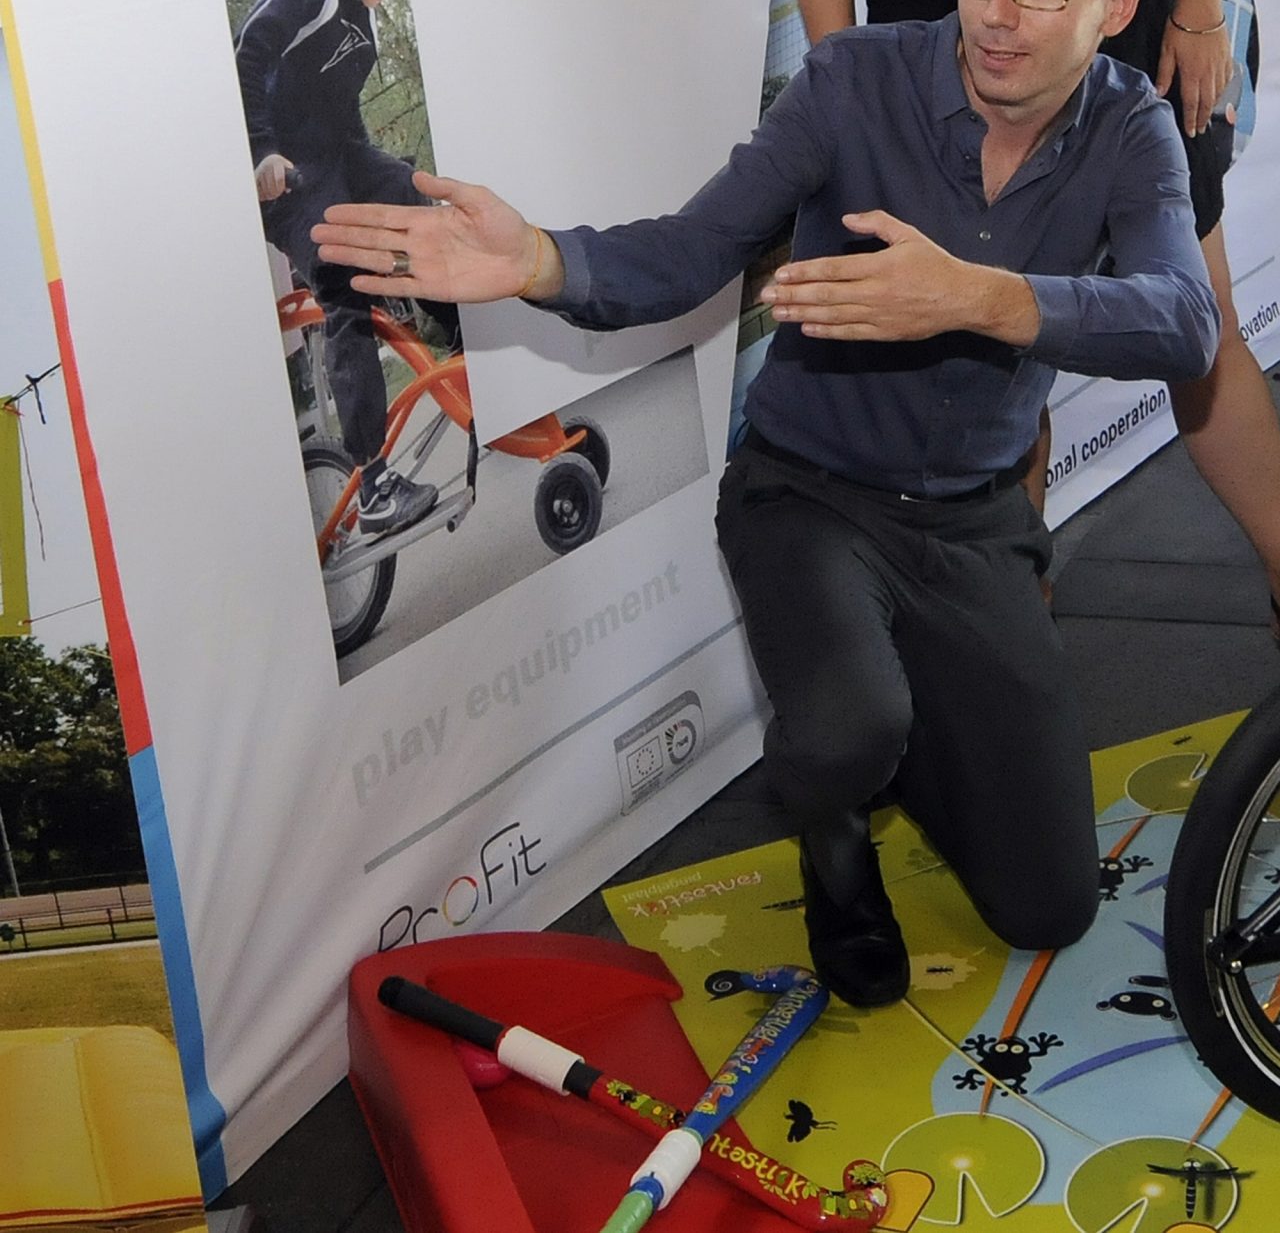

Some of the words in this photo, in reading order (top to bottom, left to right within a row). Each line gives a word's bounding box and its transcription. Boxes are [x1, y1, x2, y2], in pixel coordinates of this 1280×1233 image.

[1045, 444, 1078, 490] onal
[1081, 387, 1167, 462] cooperation
[1240, 300, 1280, 343] ovation
[351, 705, 449, 810] play
[465, 560, 683, 720] equipment
